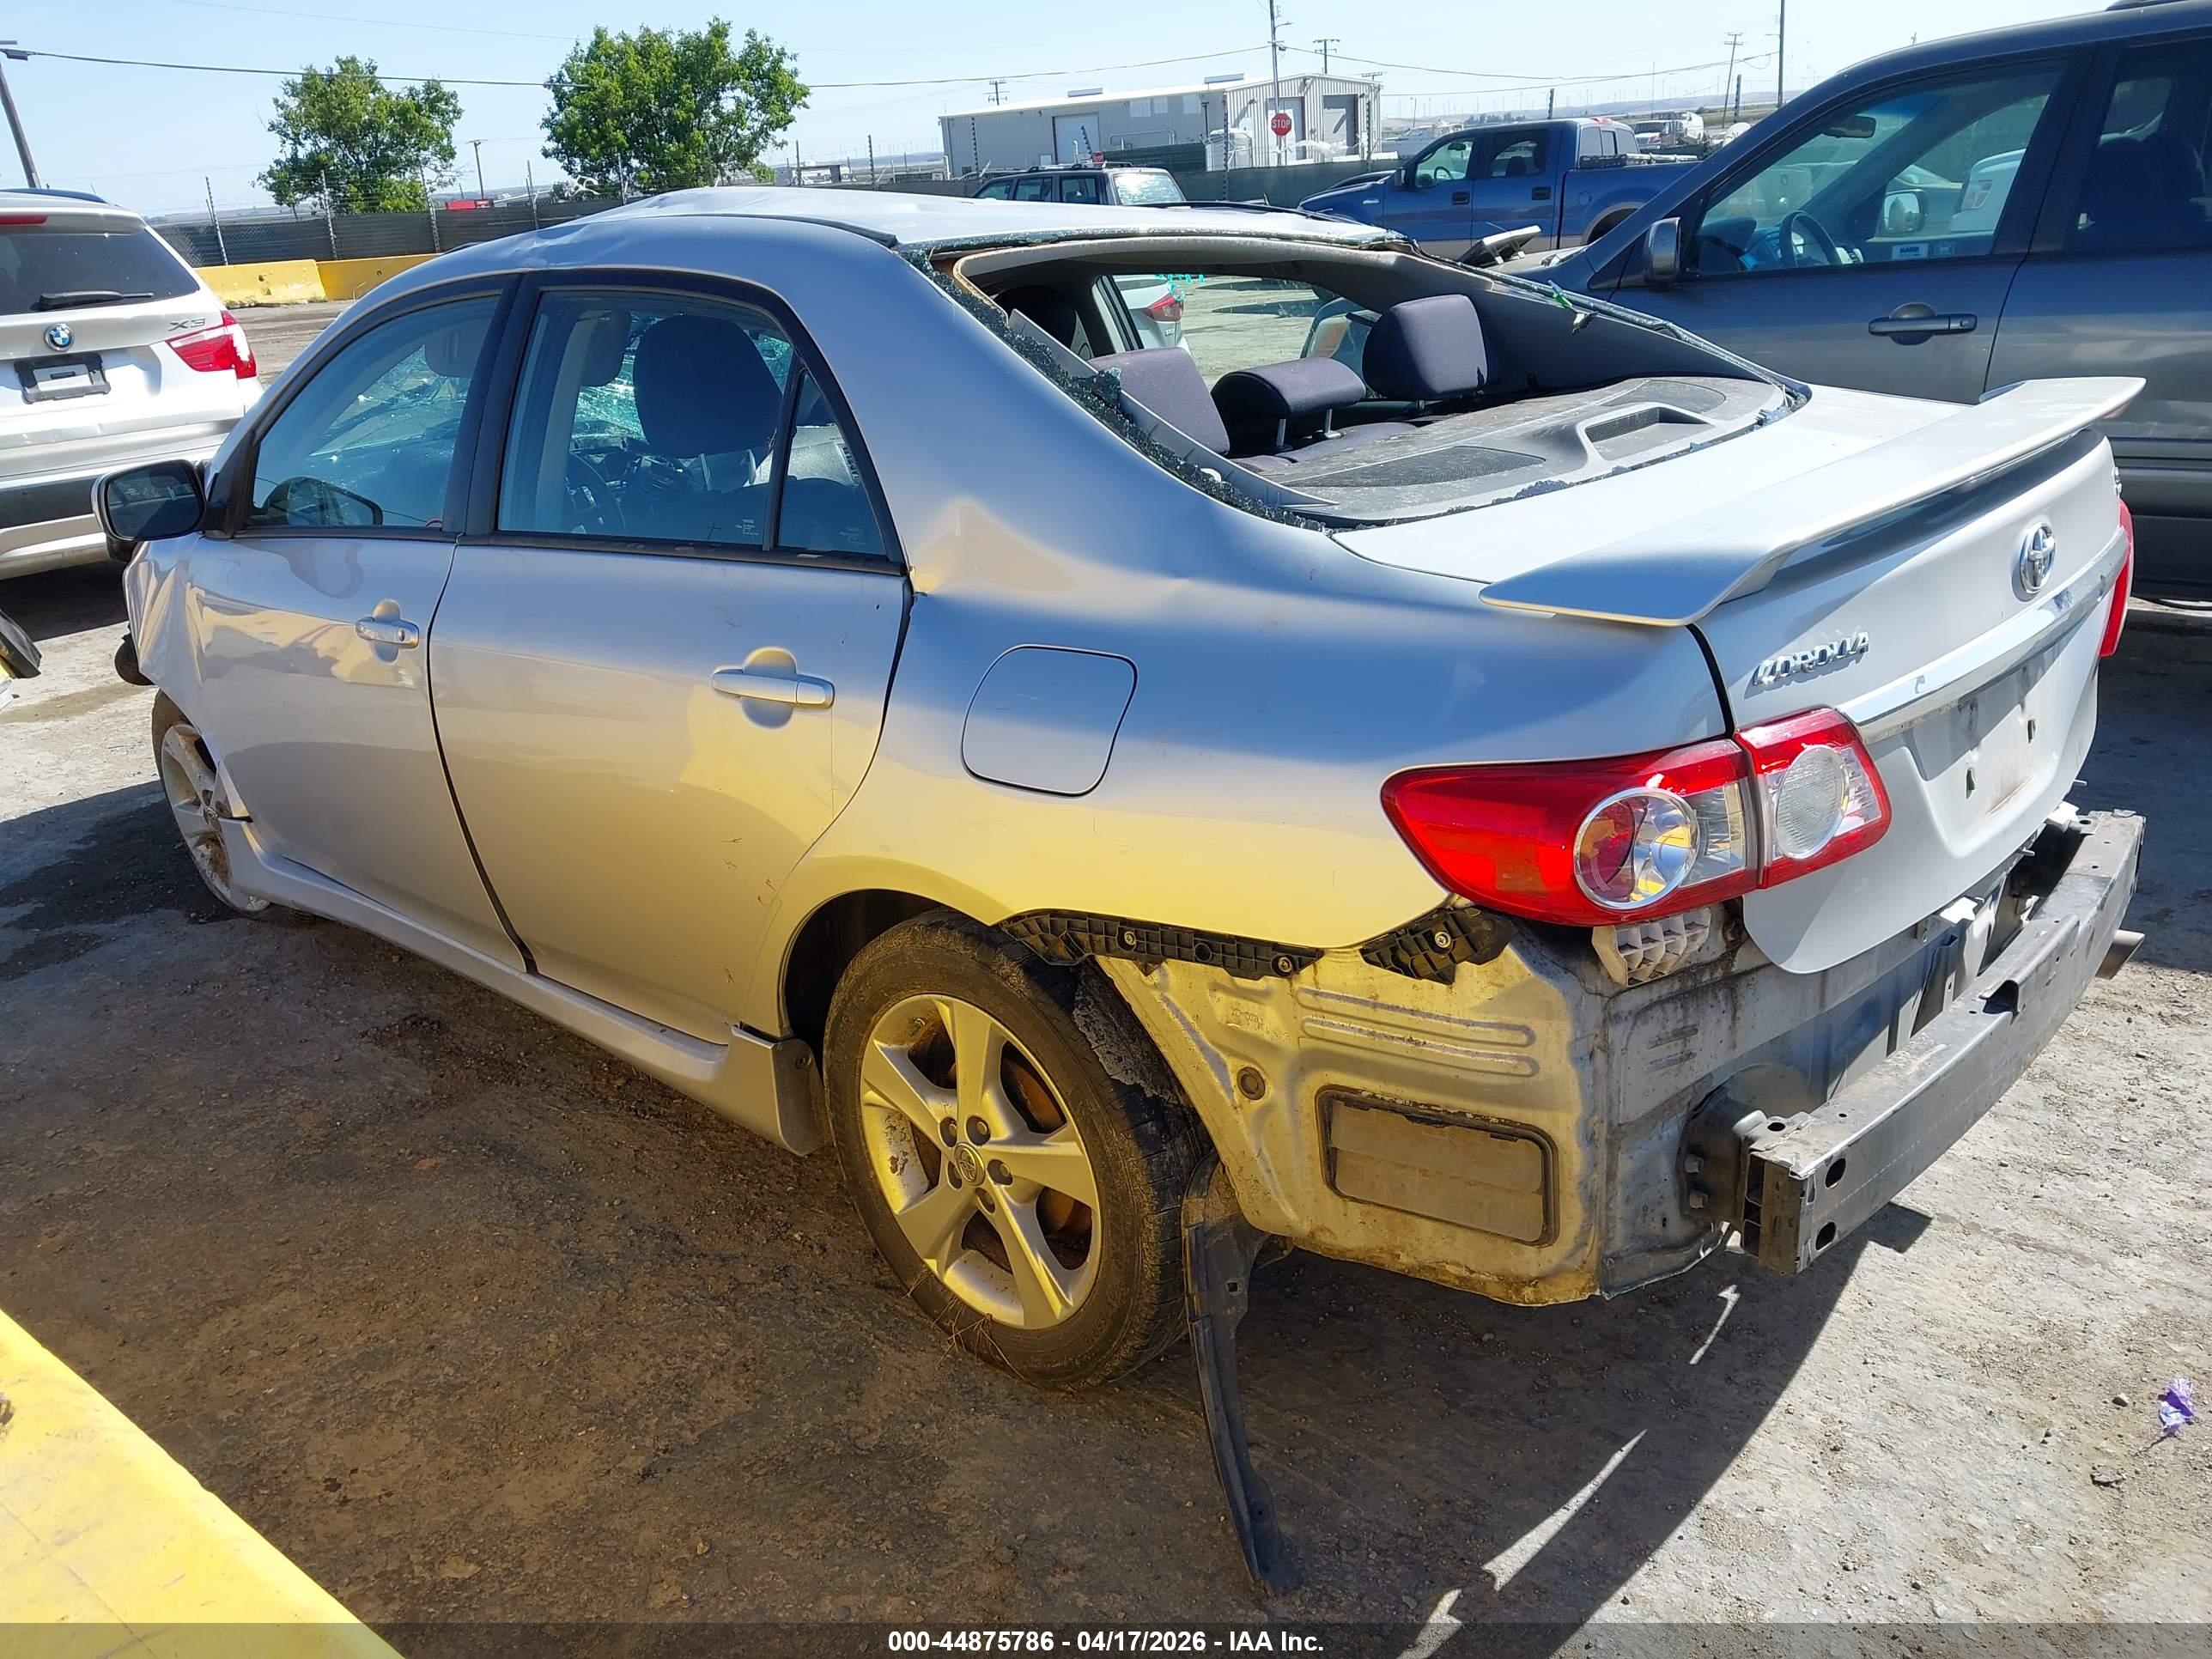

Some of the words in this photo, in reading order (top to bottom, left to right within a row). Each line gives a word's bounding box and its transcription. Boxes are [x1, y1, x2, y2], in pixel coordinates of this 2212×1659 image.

[1272, 119, 1291, 129] STOP
[168, 318, 205, 331] X3
[1753, 631, 1869, 686] COROLLA
